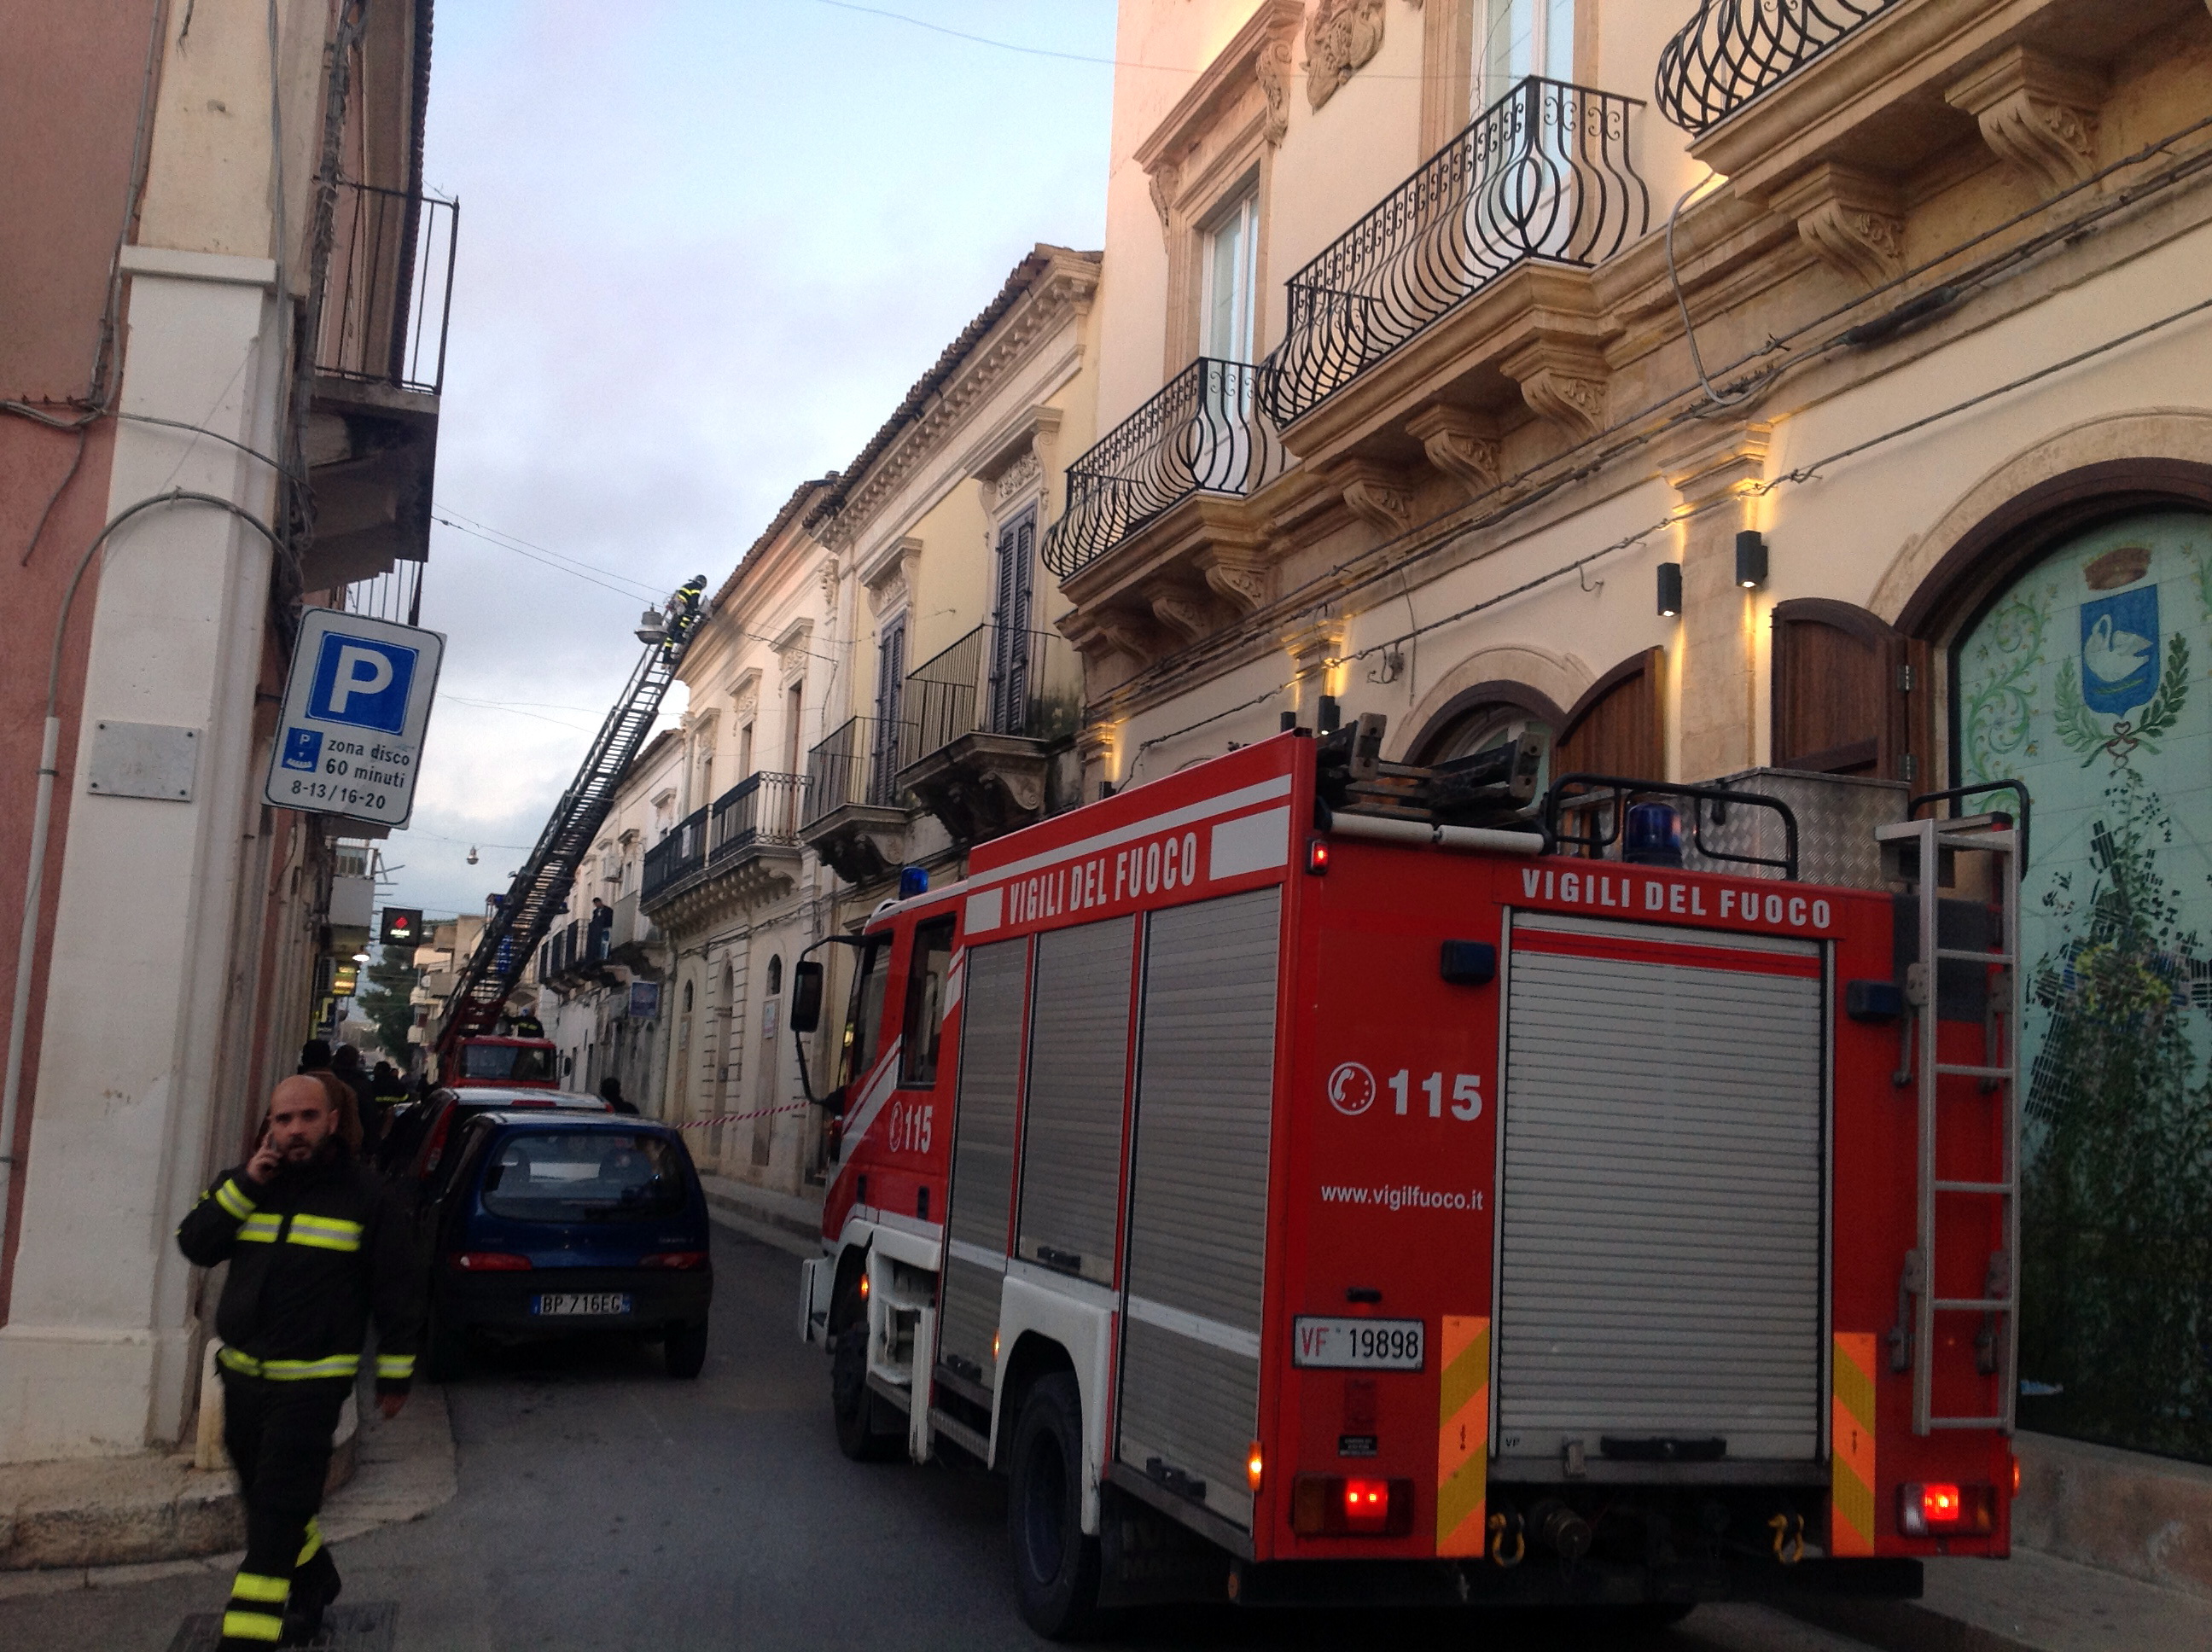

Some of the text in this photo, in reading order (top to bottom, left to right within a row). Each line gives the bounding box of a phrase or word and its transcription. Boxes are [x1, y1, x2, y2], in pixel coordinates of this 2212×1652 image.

[329, 645, 393, 713] P
[326, 759, 405, 788] 60 minuti
[328, 740, 410, 766] zona disco
[1010, 832, 1196, 925] VIGILI DEL FUOCO
[1522, 868, 1831, 929] VIGILI DEL FUOCO
[1388, 1068, 1483, 1122] 115
[905, 1104, 933, 1154] 115
[1321, 1184, 1484, 1212] www.vigilfuoco.it
[543, 1296, 563, 1312] BP
[1301, 1326, 1419, 1359] VF 19898
